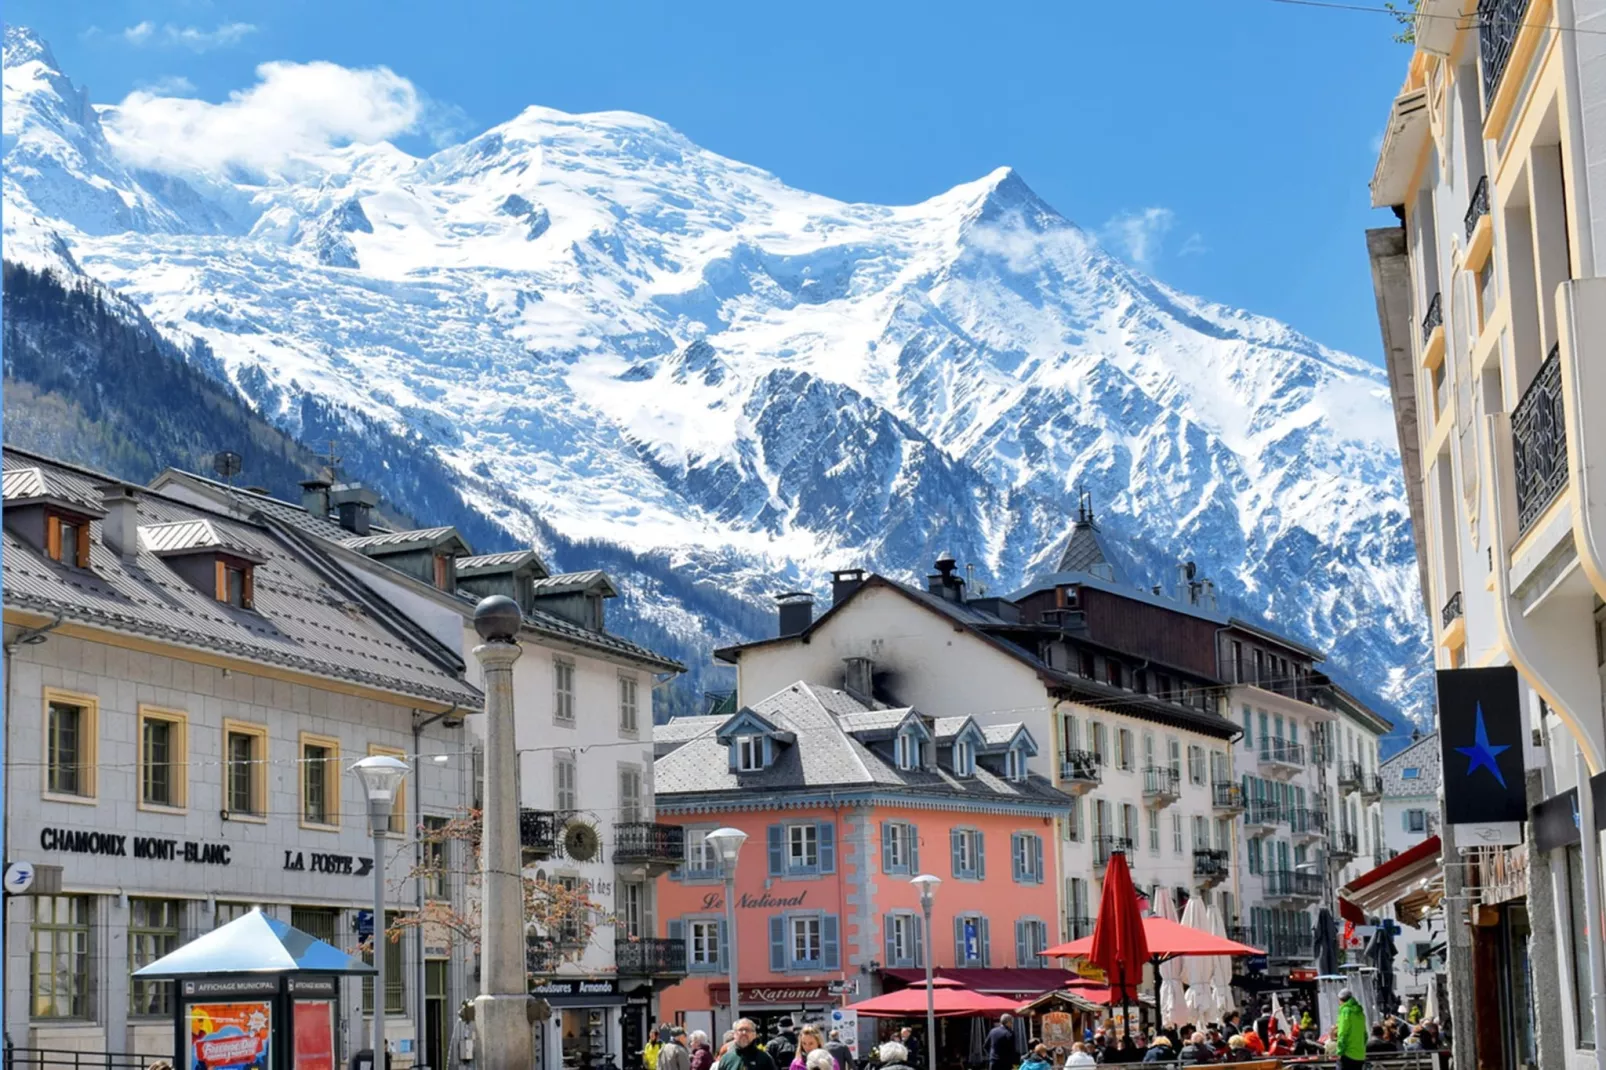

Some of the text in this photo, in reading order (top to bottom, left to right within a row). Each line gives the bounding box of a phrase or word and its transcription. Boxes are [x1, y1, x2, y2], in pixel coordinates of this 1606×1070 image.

[40, 827, 231, 865] CHAMONIX MONT-BLANC
[283, 850, 353, 875] LA POSTE
[701, 890, 808, 911] Le National
[198, 981, 275, 992] AFFICHAGE MUNICIPAL
[749, 987, 823, 1002] National
